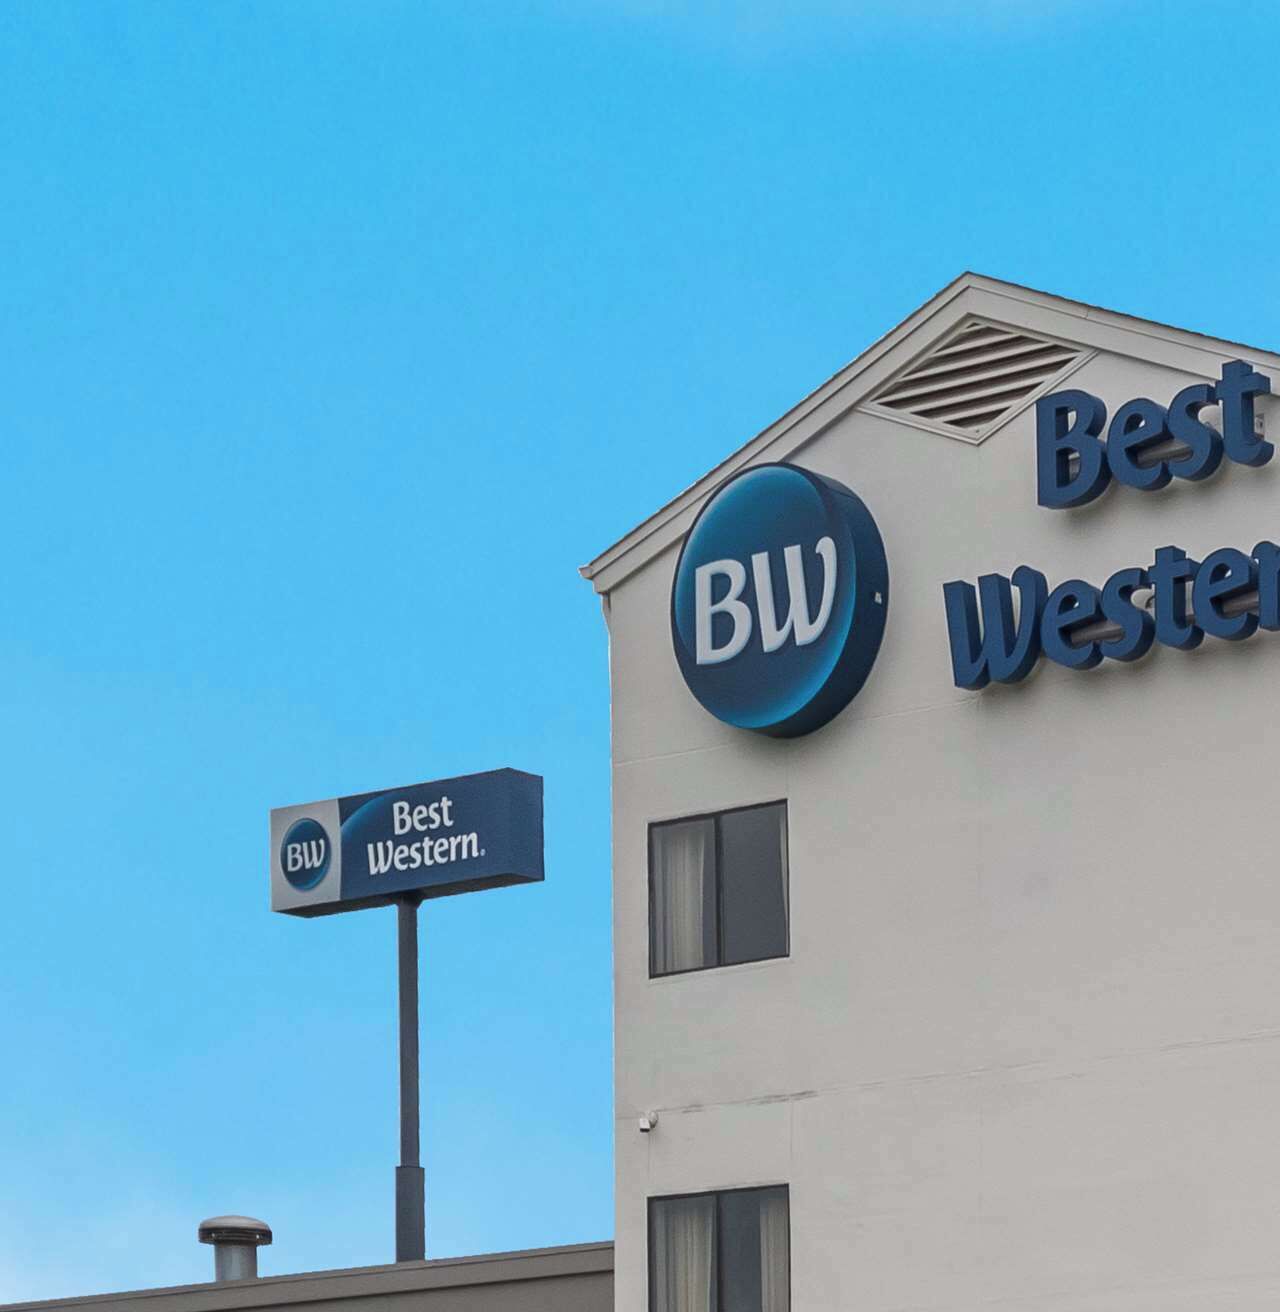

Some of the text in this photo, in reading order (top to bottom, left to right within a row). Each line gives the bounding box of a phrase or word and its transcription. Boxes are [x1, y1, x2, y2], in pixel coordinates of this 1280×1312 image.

[1037, 359, 1274, 510] Best
[695, 536, 837, 665] BW
[393, 796, 454, 835] Best
[287, 839, 325, 872] BW
[367, 832, 480, 875] Western
